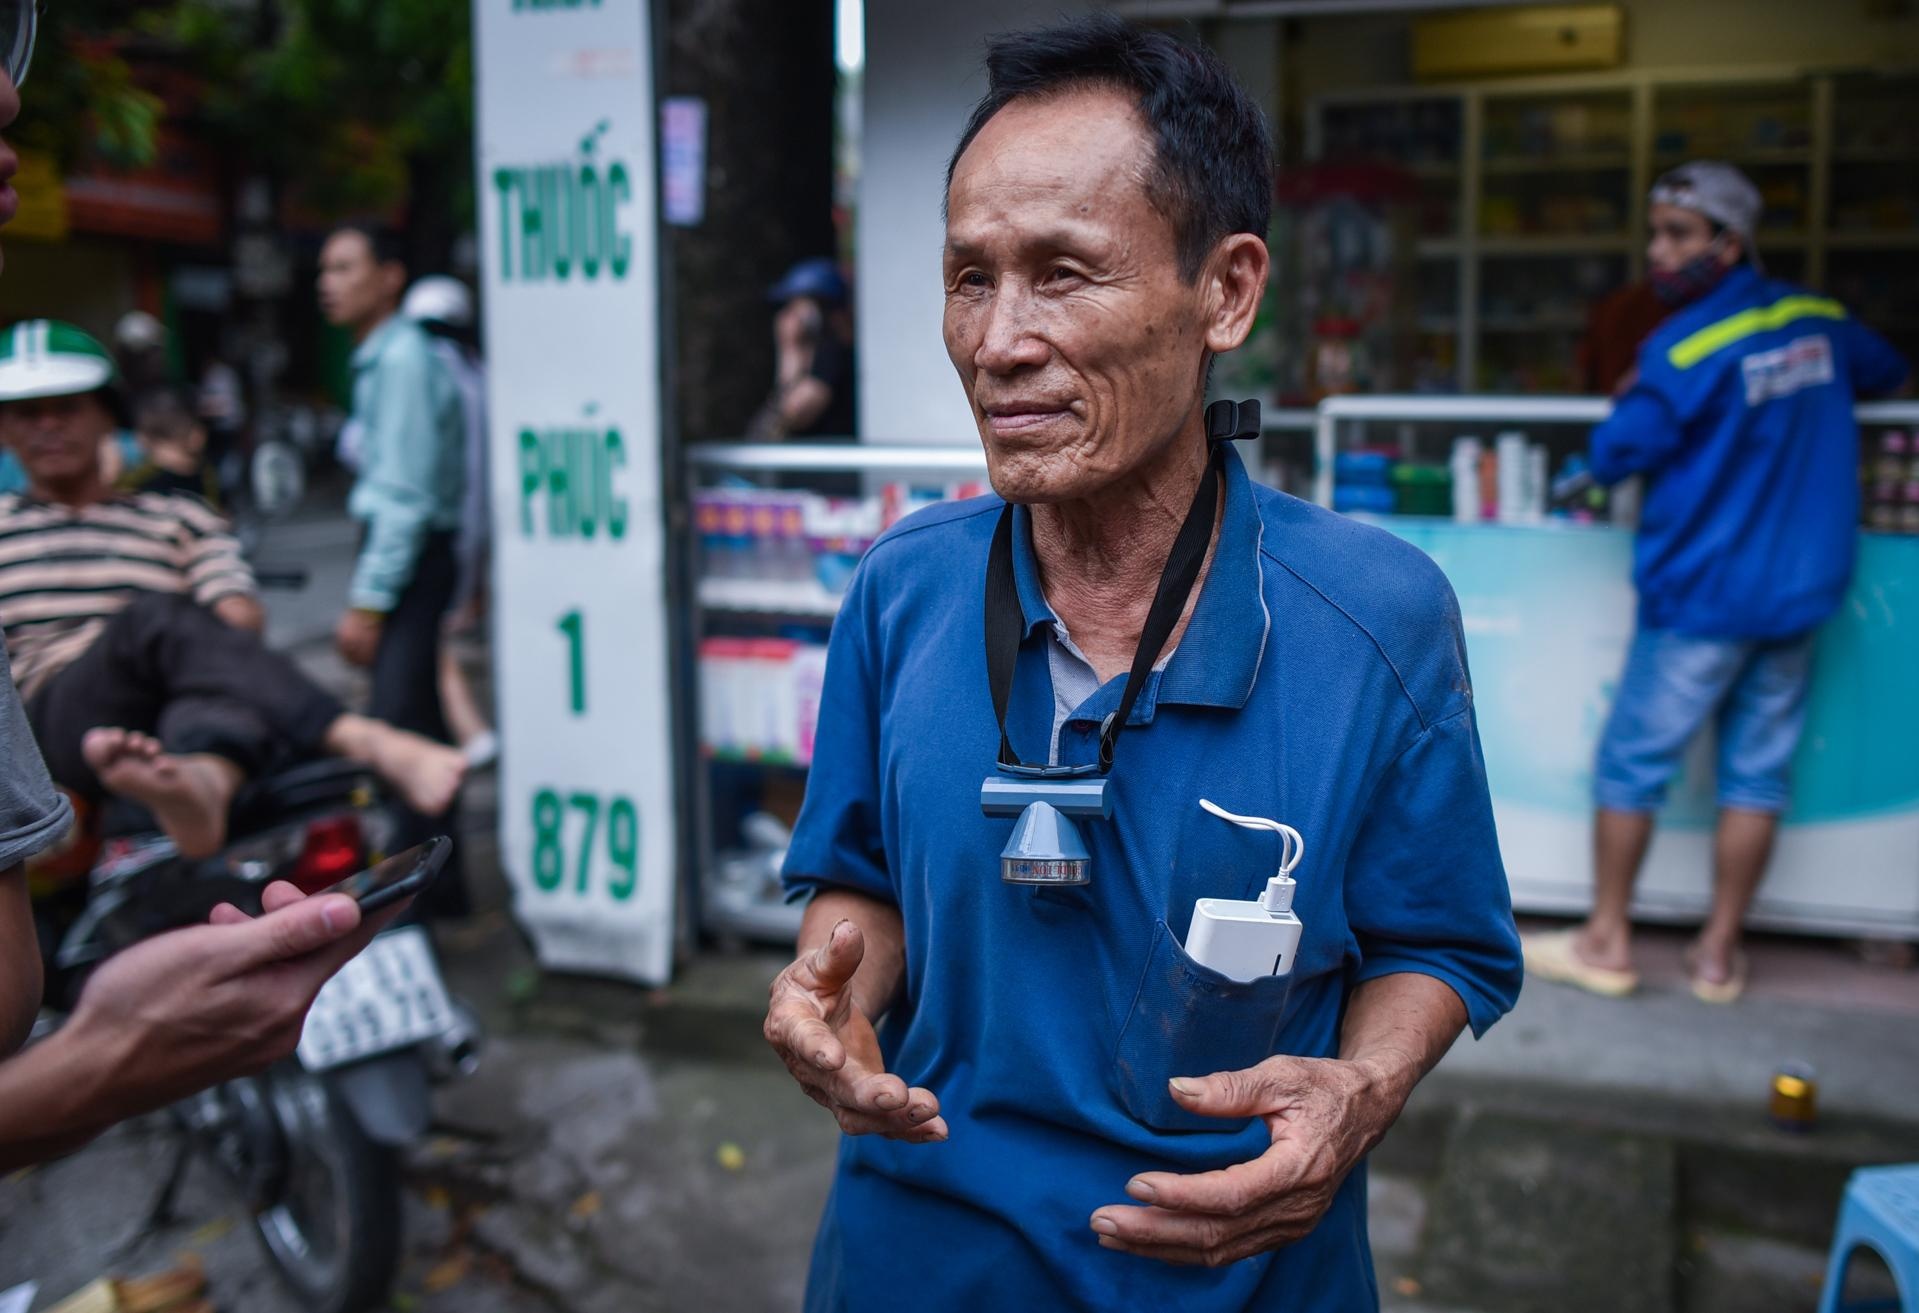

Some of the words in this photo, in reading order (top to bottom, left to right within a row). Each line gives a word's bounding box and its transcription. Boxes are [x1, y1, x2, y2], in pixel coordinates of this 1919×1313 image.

[493, 120, 632, 283] THUỐC
[517, 402, 630, 541] PHÚC
[555, 608, 587, 717] 1
[530, 786, 640, 903] 879
